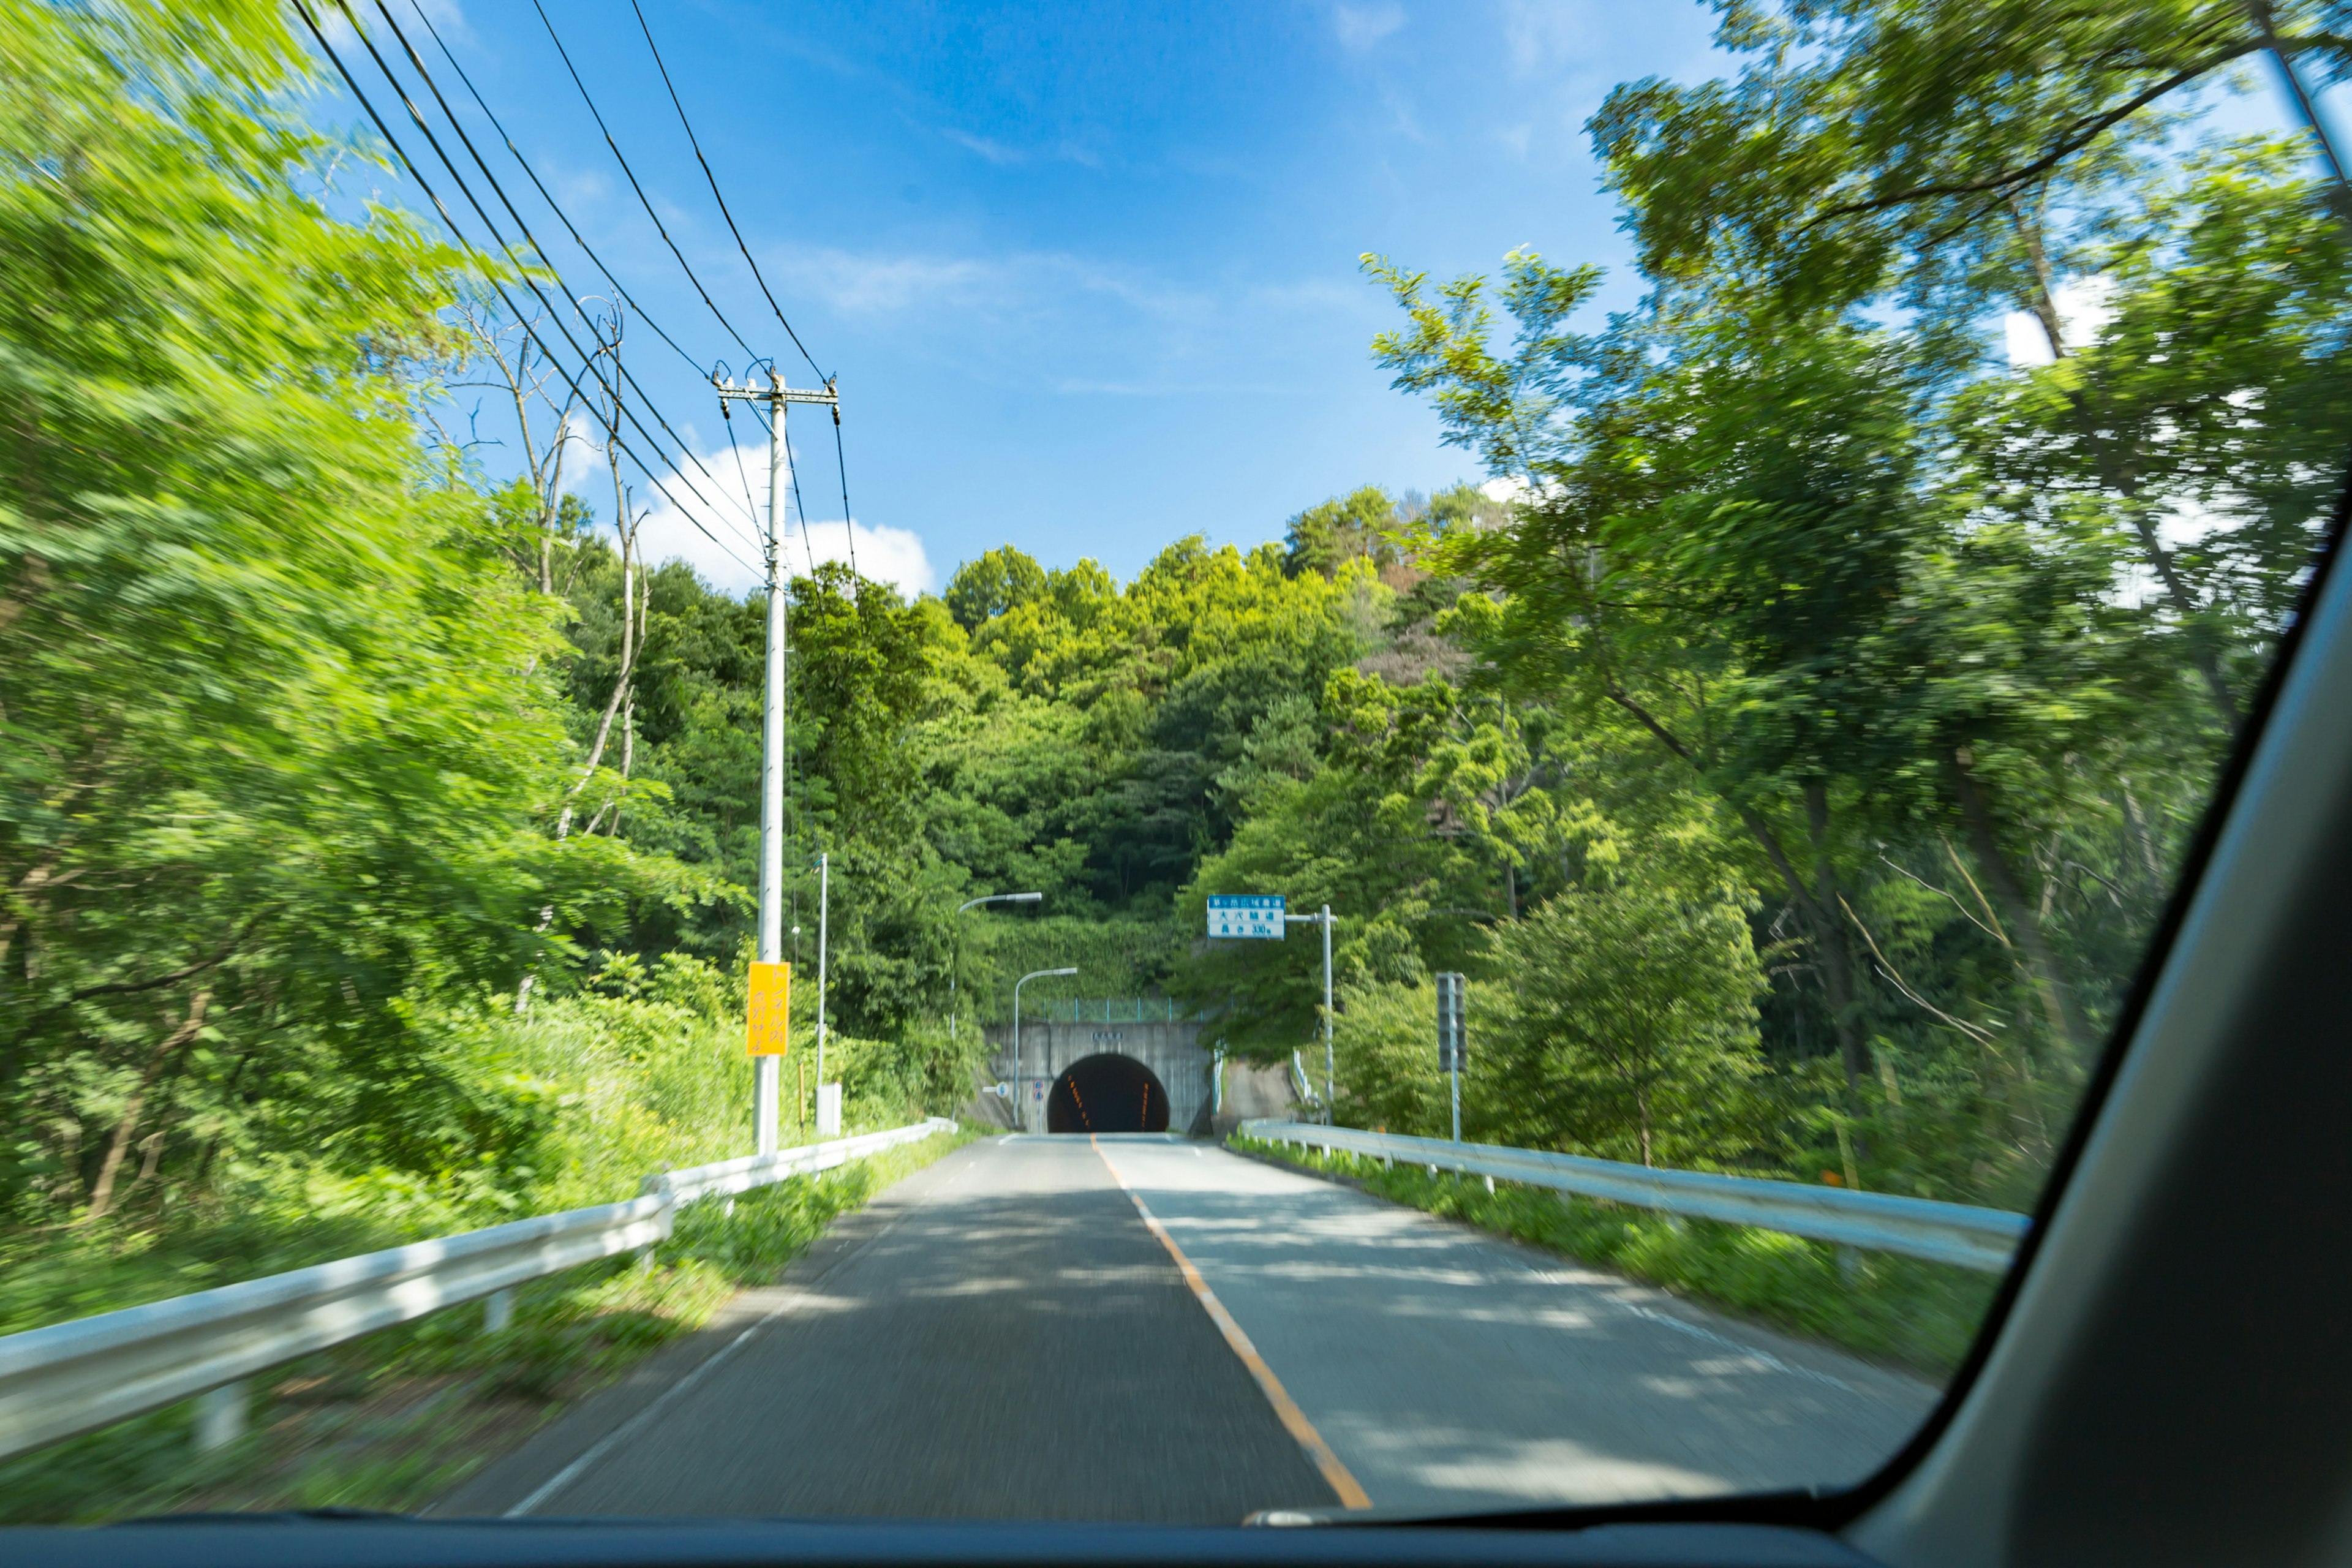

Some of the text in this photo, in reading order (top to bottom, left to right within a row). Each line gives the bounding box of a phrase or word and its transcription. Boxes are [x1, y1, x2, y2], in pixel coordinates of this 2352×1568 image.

[769, 966, 785, 1044] トンネル内
